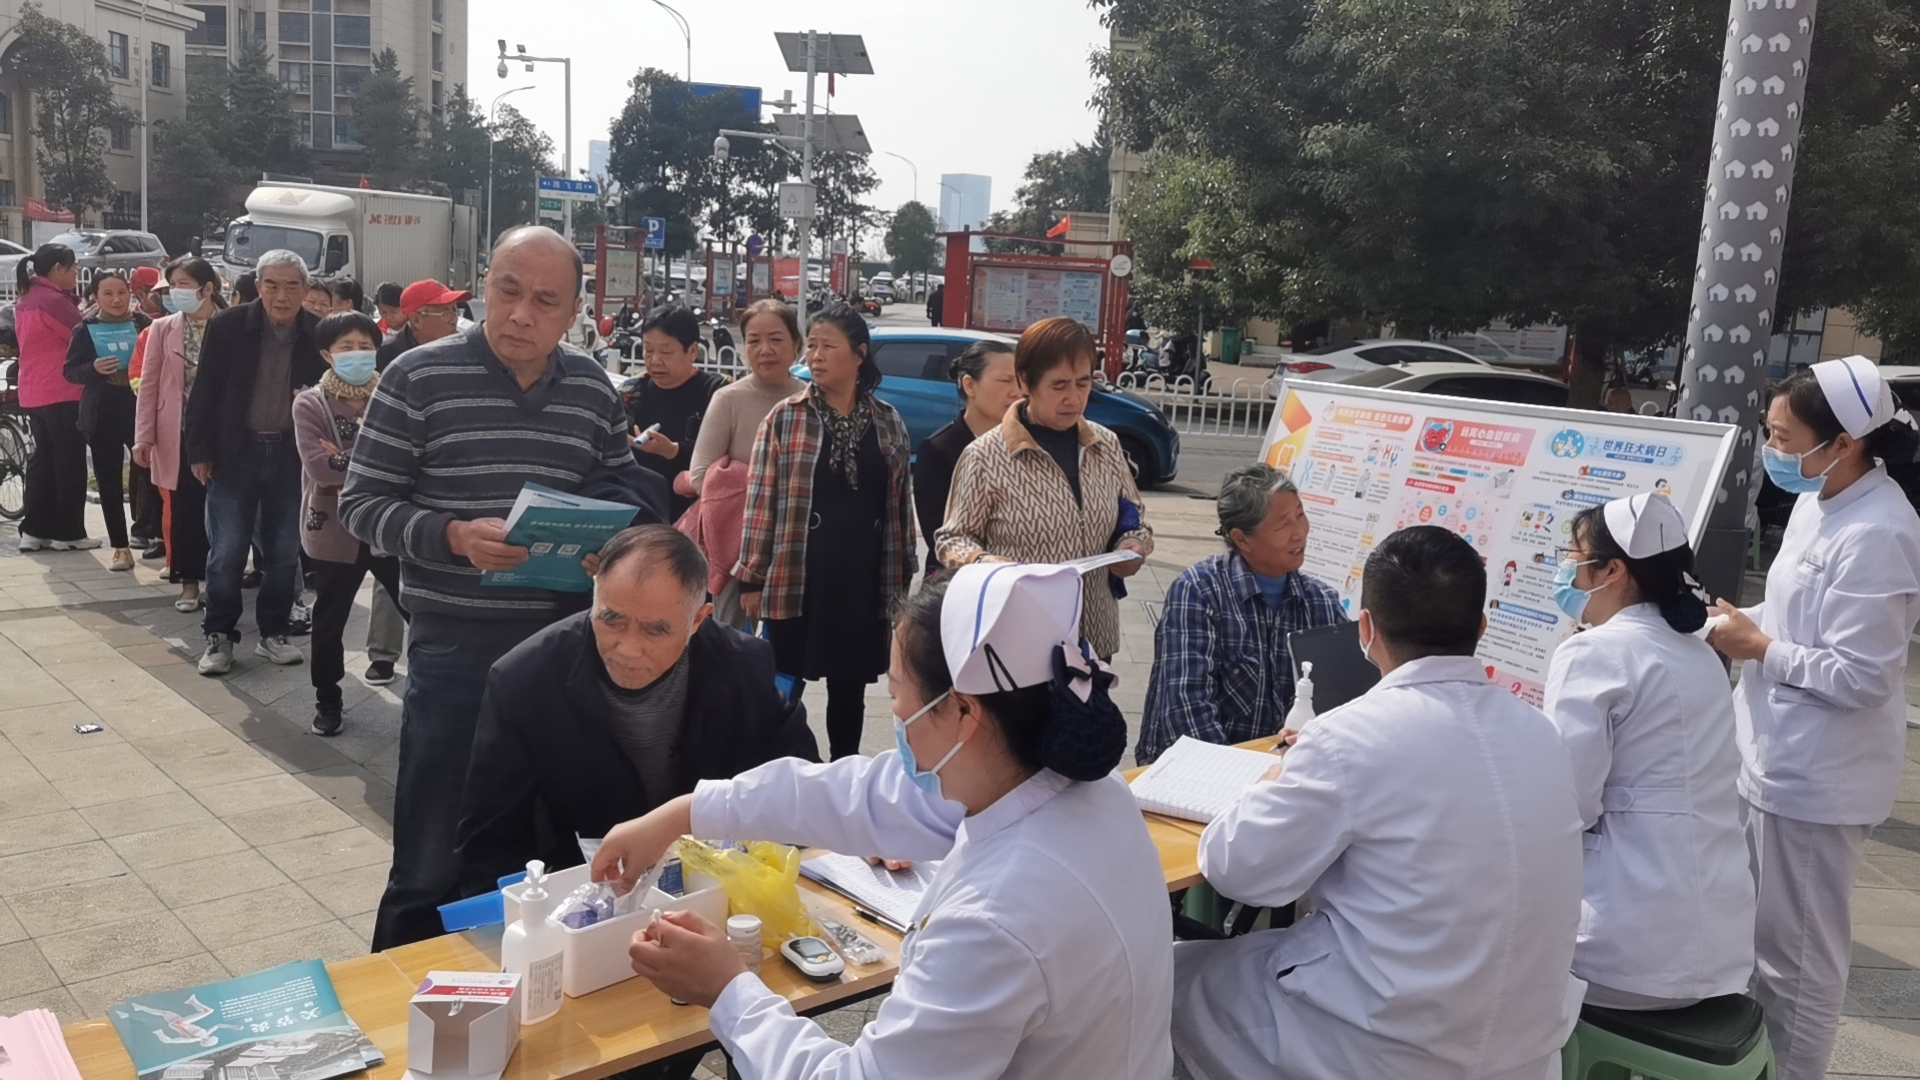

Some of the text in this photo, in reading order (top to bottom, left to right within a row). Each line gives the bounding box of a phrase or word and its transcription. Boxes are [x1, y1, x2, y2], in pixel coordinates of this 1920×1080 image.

[648, 219, 660, 237] P
[1603, 440, 1667, 457] 世界狂犬病日
